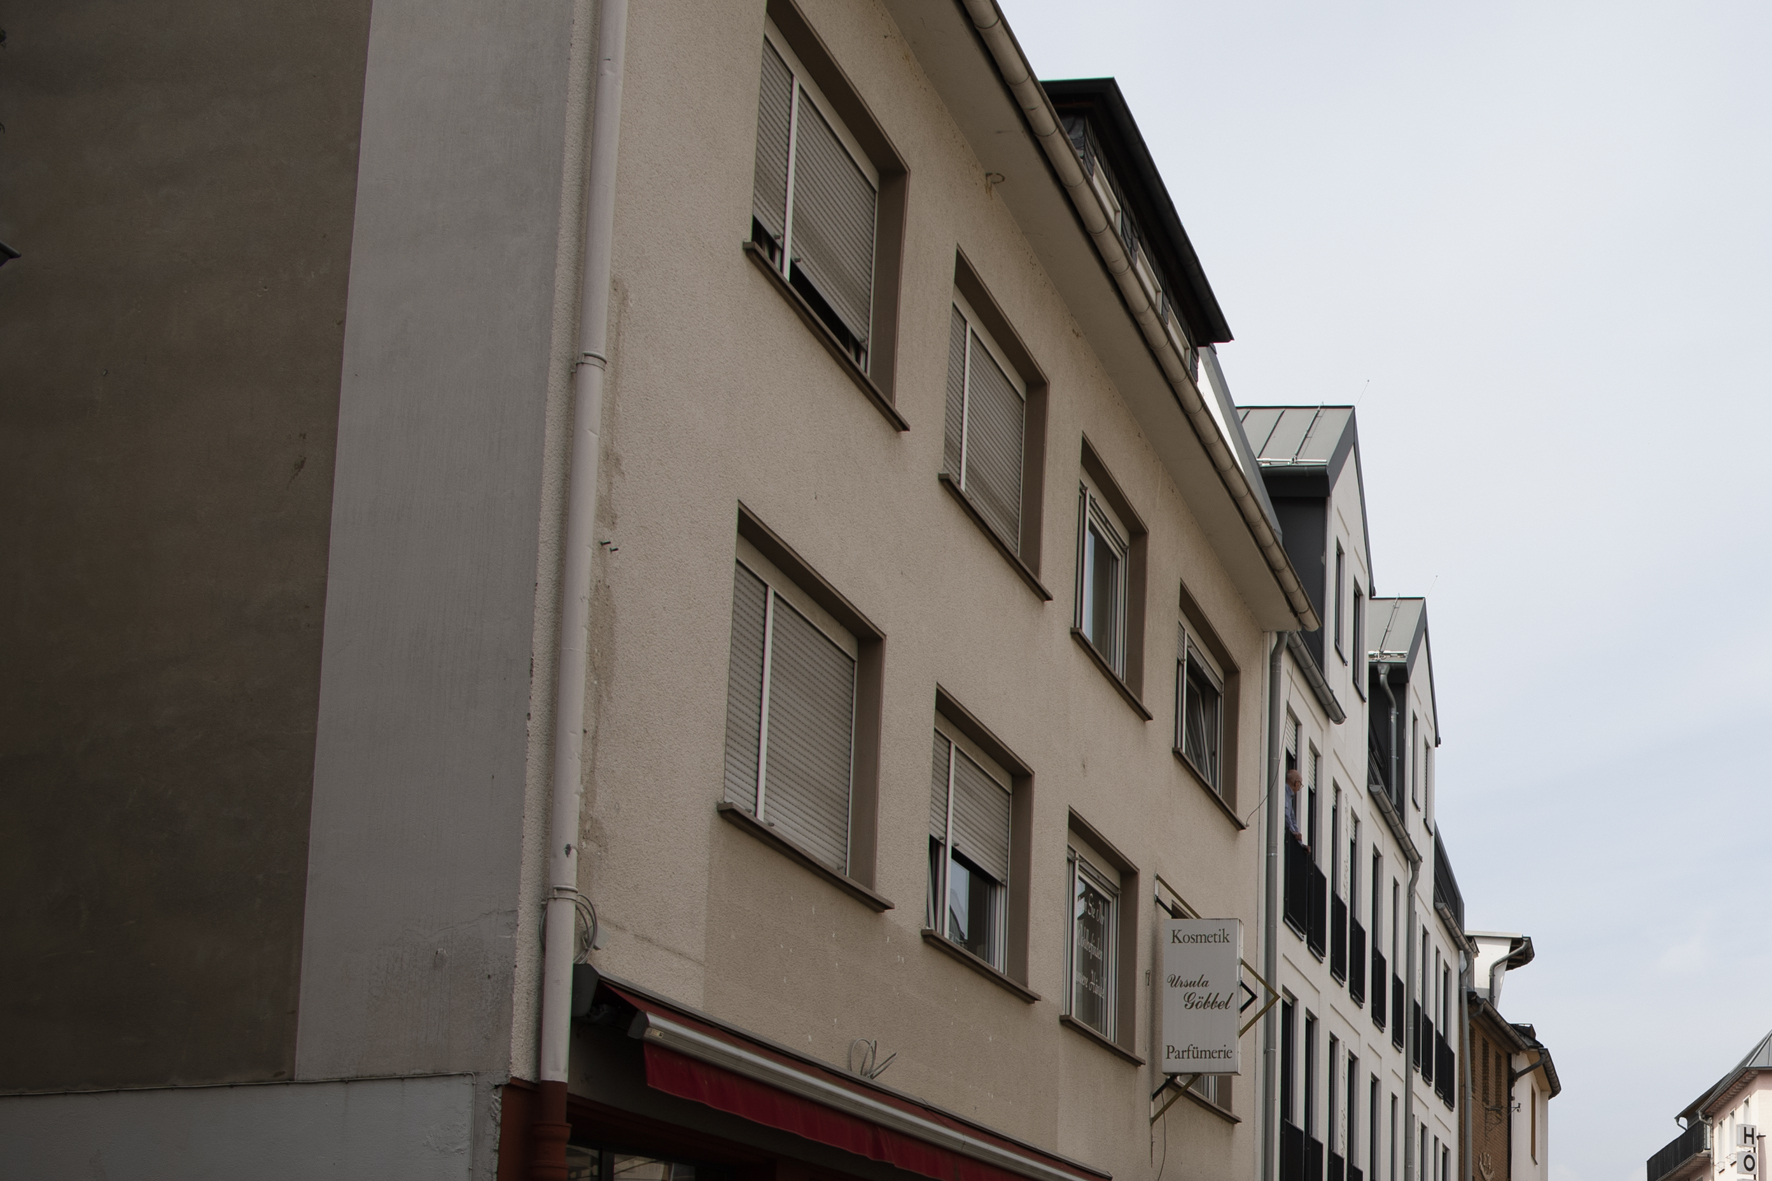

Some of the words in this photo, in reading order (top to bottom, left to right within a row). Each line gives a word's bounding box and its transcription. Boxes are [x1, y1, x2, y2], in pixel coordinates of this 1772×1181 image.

[1171, 928, 1230, 944] Kosmetik
[1167, 973, 1210, 988] Ursula
[1183, 992, 1234, 1010] Göbbel
[1165, 1044, 1233, 1060] Parfümerie
